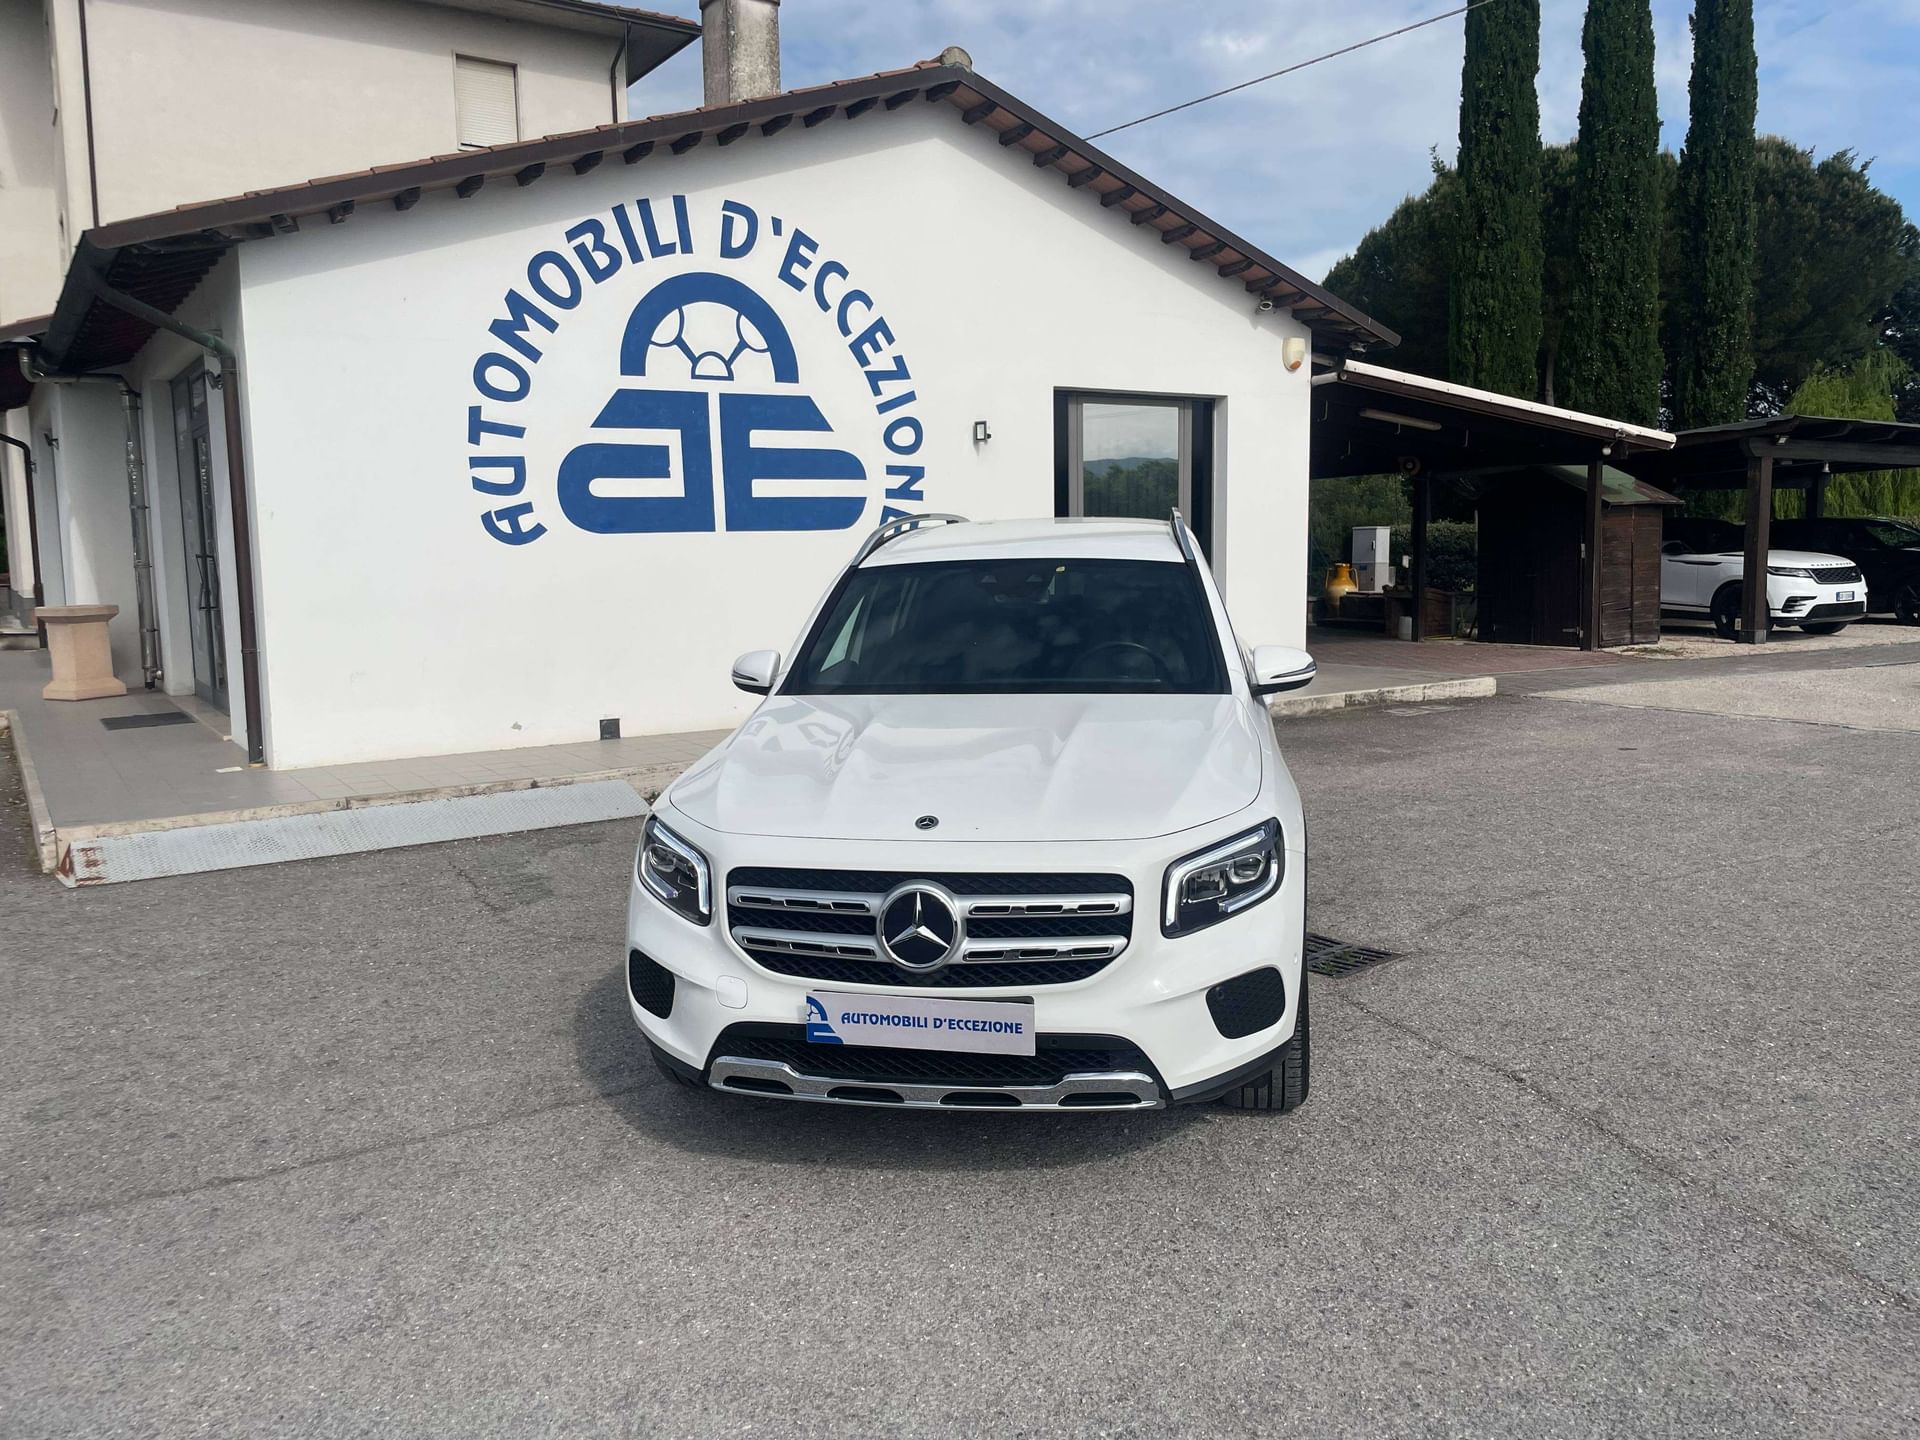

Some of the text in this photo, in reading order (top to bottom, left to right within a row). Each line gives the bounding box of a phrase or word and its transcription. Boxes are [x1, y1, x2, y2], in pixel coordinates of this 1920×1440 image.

[469, 195, 693, 545] AUTOMOBILI
[841, 1011, 1023, 1034] AUTOMOBILI D'ECCEZIONE
